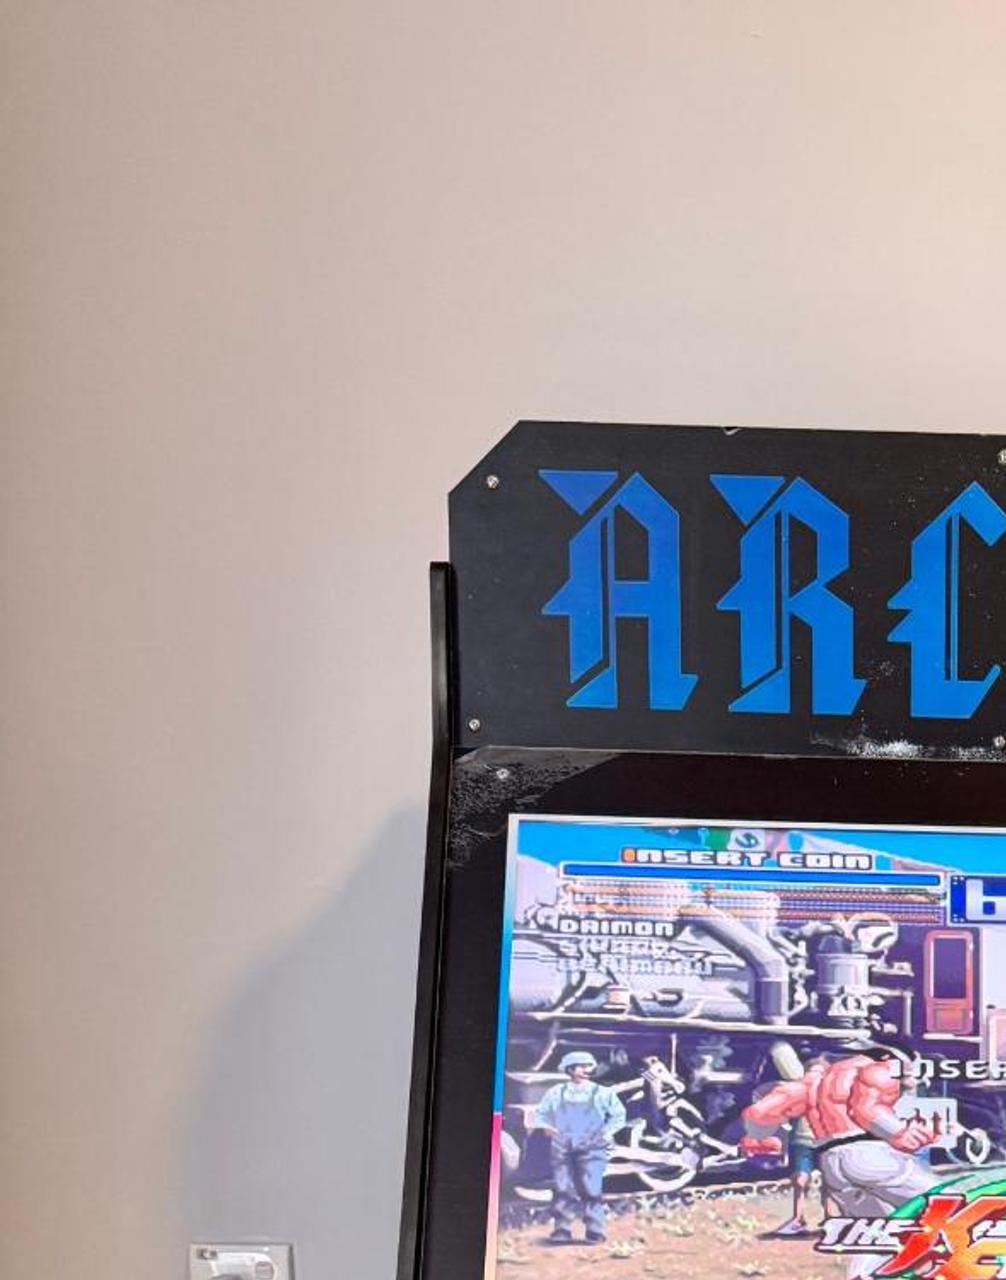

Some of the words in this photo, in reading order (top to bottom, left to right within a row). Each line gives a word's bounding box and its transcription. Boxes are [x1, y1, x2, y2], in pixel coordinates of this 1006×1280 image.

[777, 851, 874, 871] COIN
[559, 918, 675, 937] DAIMON
[814, 1216, 922, 1253] THE
